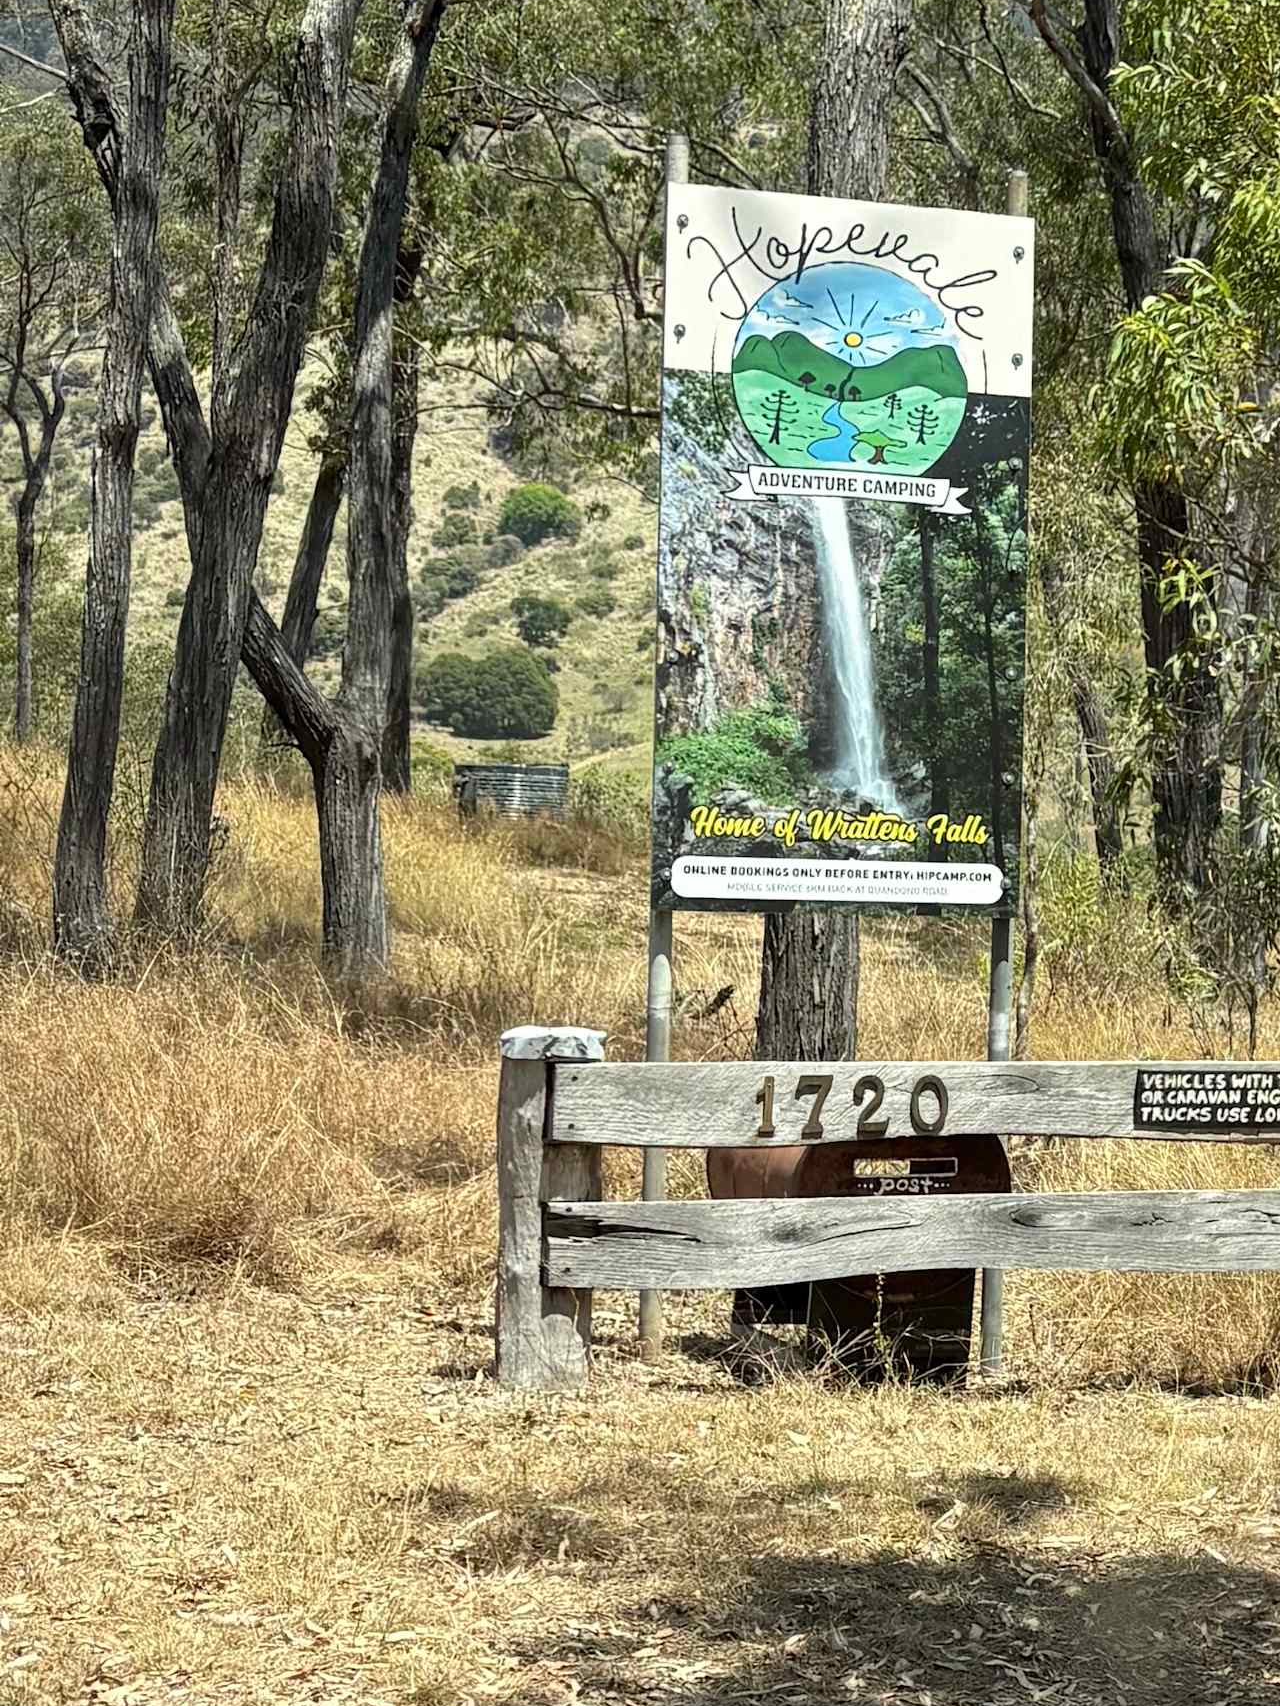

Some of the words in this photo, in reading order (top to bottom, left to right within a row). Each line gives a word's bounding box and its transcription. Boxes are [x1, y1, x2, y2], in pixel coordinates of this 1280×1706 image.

[687, 206, 997, 340] Hopevale
[758, 472, 857, 493] ADVENTURE
[858, 479, 936, 498] CAMPING
[690, 805, 766, 839] Home
[772, 808, 802, 847] of
[806, 808, 919, 844] Wrattens
[926, 812, 990, 845] Falls
[683, 864, 727, 875] ONLINE
[731, 866, 789, 877] BOOKINGS
[792, 867, 822, 878] ONLY
[825, 868, 869, 879] BEFORE
[917, 871, 992, 882] HIPCAMP.COM
[1143, 1074, 1226, 1089] VEHICLES
[1231, 1074, 1273, 1089] WITH
[755, 1074, 949, 1139] 1720
[1141, 1090, 1164, 1104] OR
[1167, 1090, 1241, 1104] CARAVAN
[1140, 1106, 1212, 1122] TRUCKS
[1217, 1107, 1251, 1123] USE
